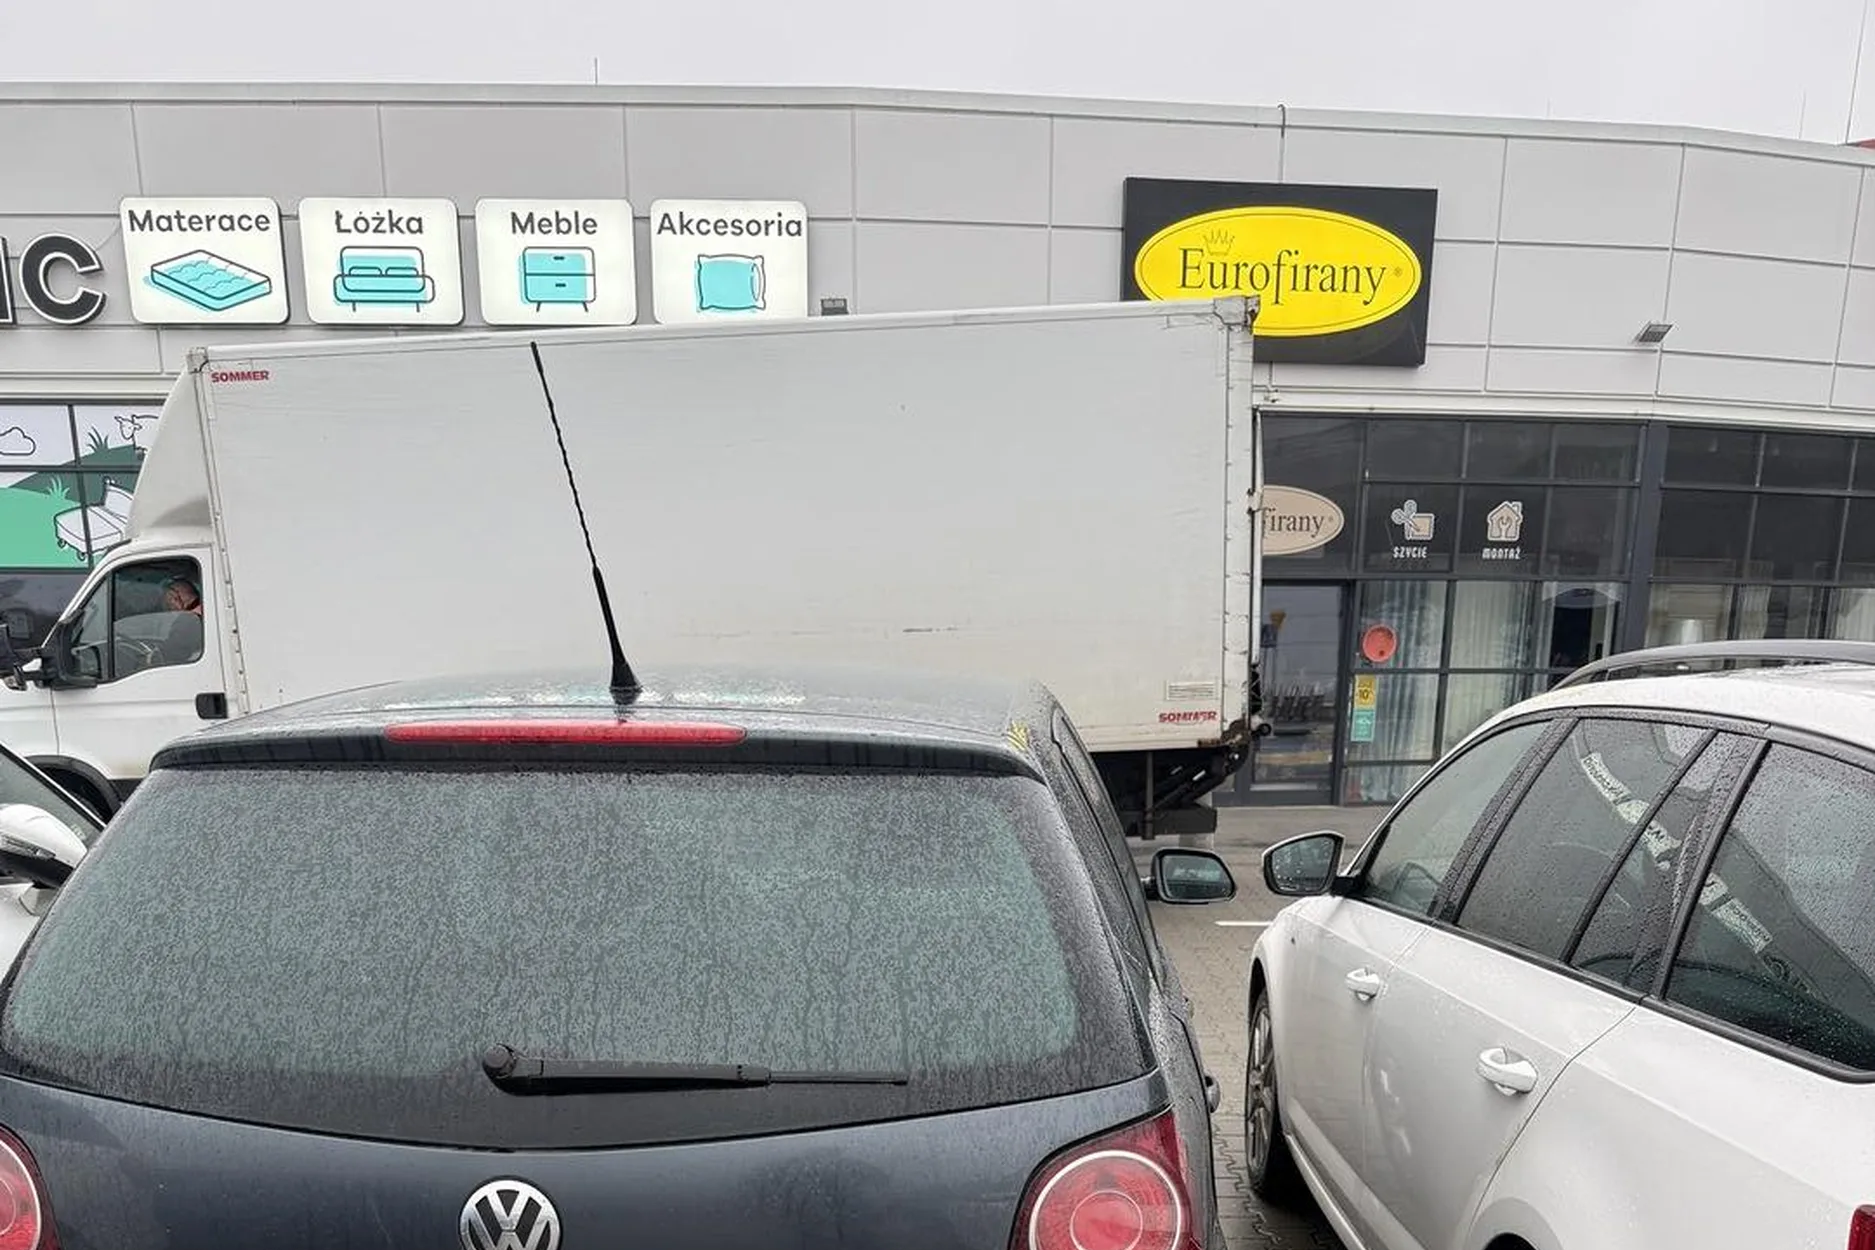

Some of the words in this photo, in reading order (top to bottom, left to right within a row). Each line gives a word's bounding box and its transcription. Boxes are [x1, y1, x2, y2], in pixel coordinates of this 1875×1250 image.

[128, 208, 271, 234] Materace
[335, 209, 424, 235] Łóżka
[510, 210, 598, 235] Meble
[656, 210, 803, 239] Akcesoria
[0, 234, 107, 325] C
[1178, 247, 1386, 306] Eurofirany
[211, 370, 269, 382] SOMMER
[1393, 546, 1427, 558] SZYCIE
[1482, 546, 1520, 559] MONTAŻ
[1158, 711, 1217, 723] SOMMER
